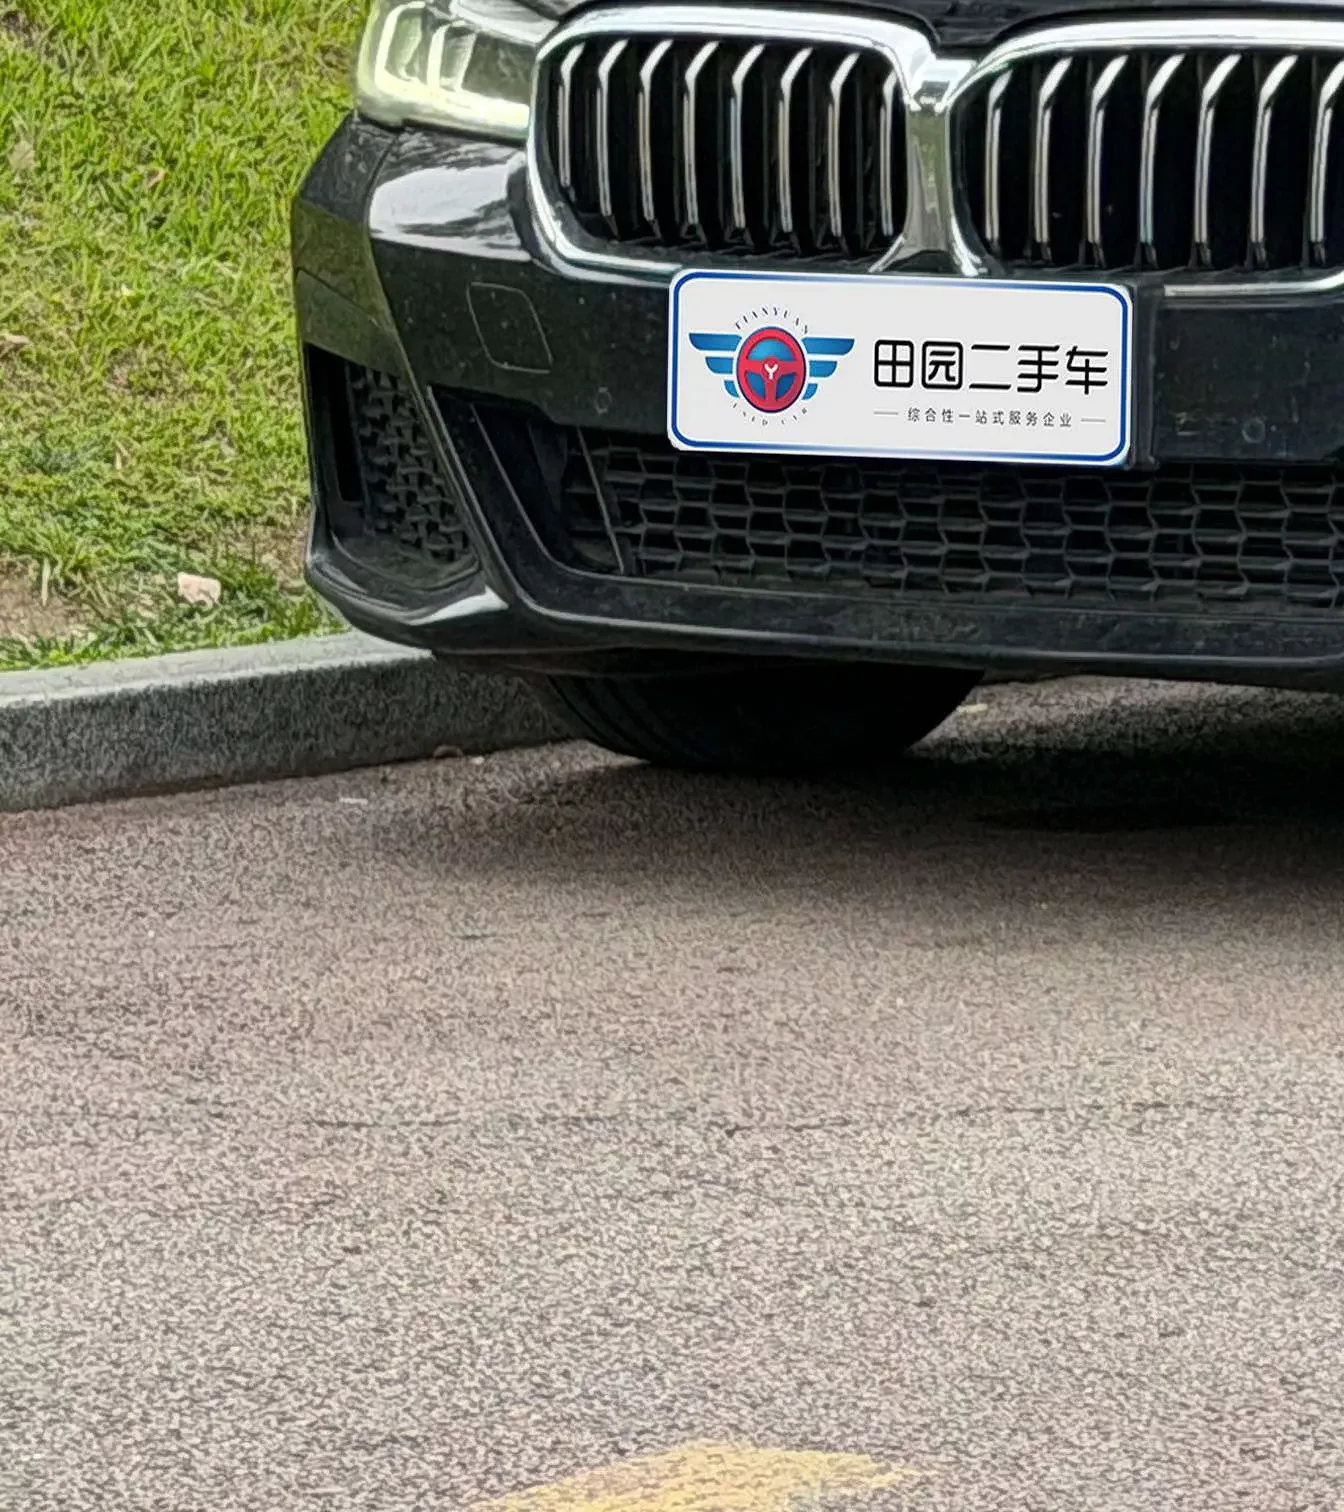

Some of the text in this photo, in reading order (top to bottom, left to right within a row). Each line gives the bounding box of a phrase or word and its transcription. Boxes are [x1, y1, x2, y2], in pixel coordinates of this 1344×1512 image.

[874, 339, 1109, 395] 田园二手车
[907, 407, 1073, 428] 综合性一站式服务企业
